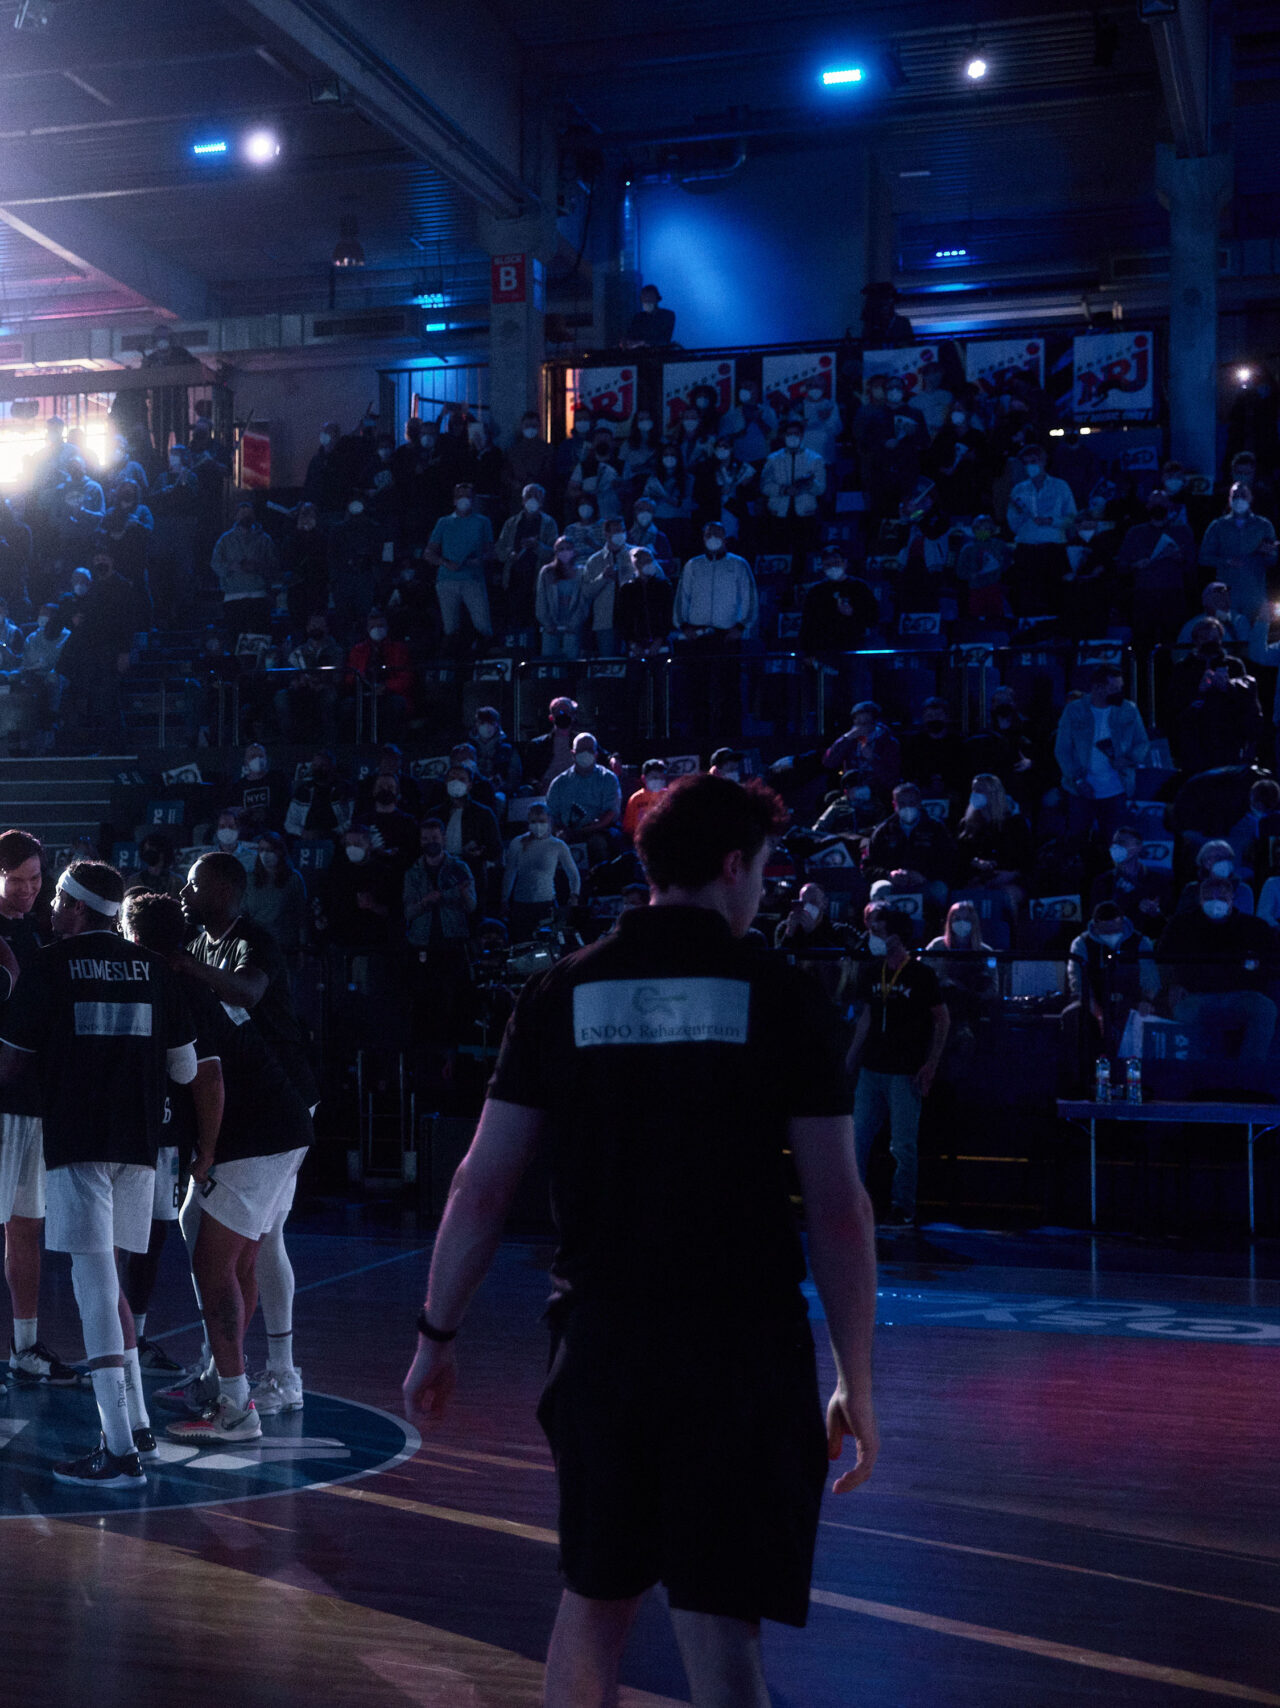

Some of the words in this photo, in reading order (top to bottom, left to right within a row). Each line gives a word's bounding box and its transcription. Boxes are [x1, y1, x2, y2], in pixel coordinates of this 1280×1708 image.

[500, 266, 518, 291] B
[246, 791, 267, 803] NYC
[68, 959, 150, 981] HOMESLEY
[580, 1024, 632, 1041] ENDO
